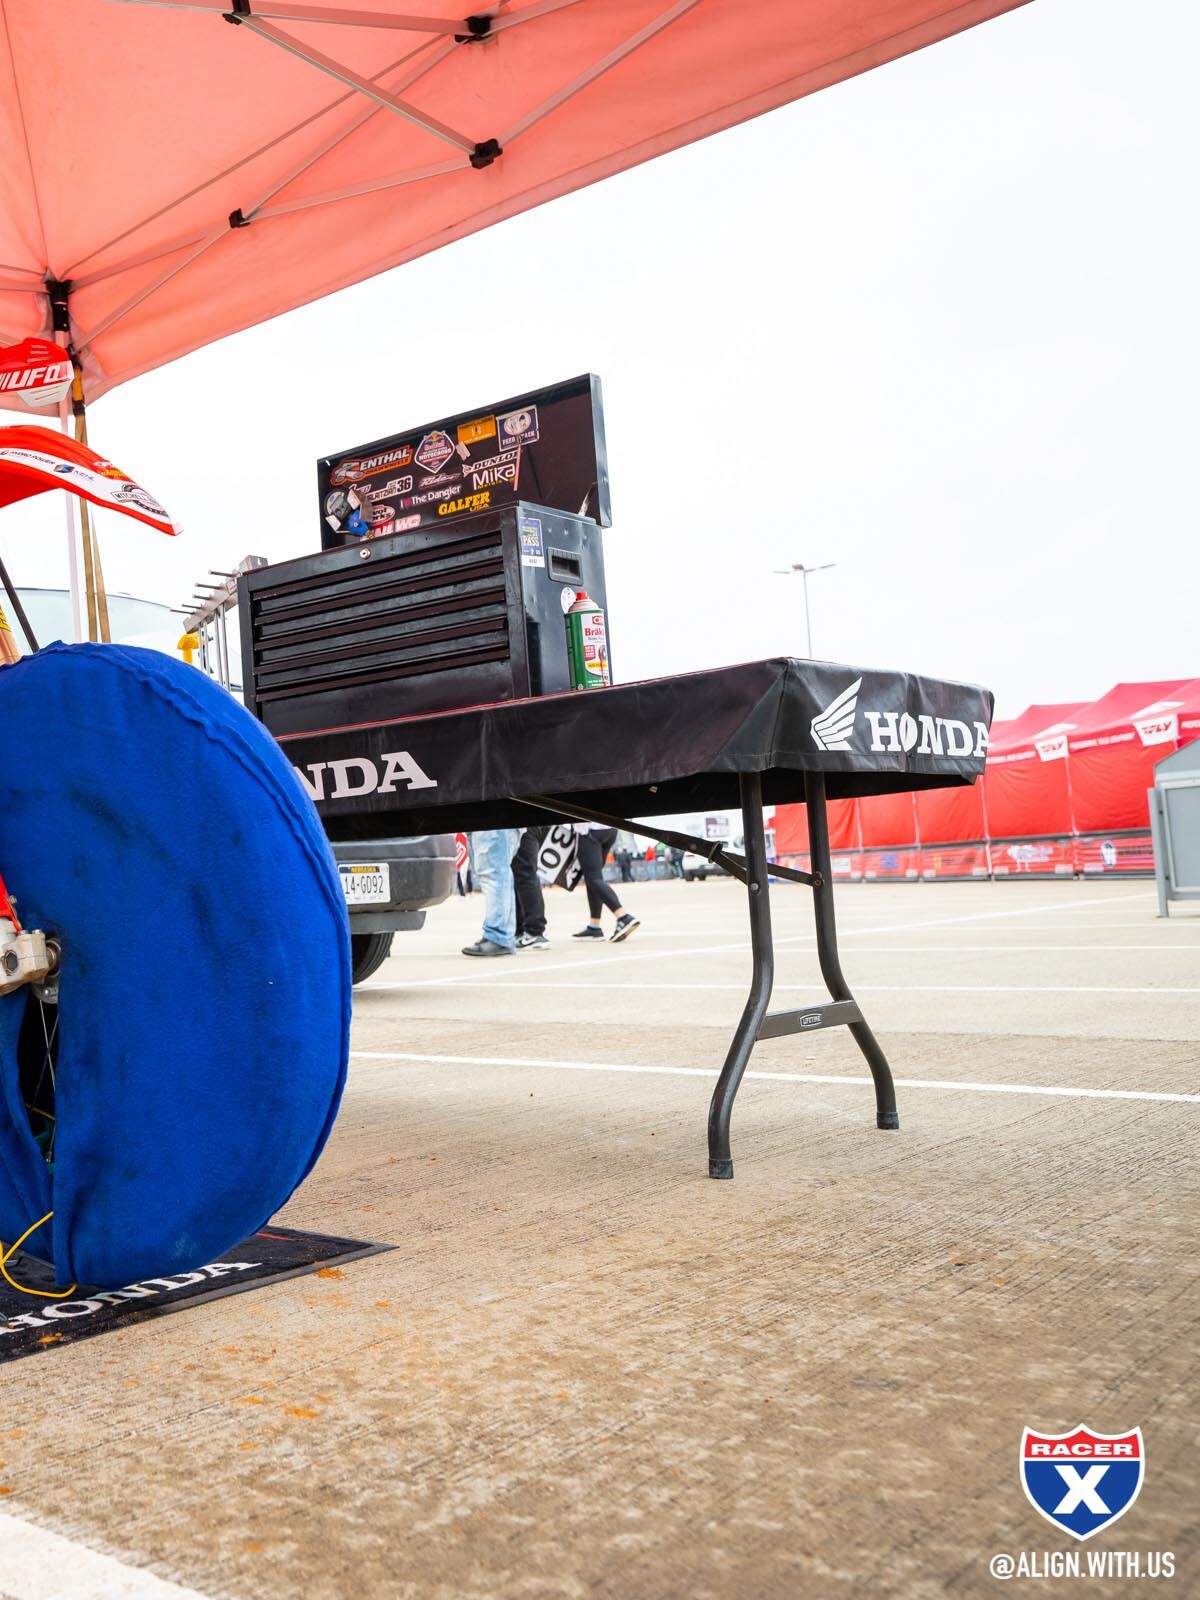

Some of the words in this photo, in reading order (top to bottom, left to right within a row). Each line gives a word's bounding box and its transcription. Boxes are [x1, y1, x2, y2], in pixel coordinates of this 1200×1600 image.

[6, 364, 62, 390] UFO
[411, 494, 426, 506] The
[428, 485, 461, 501] Dangler
[438, 491, 490, 516] GALFER
[293, 750, 438, 801] NDA
[344, 875, 384, 894] 14-GD92
